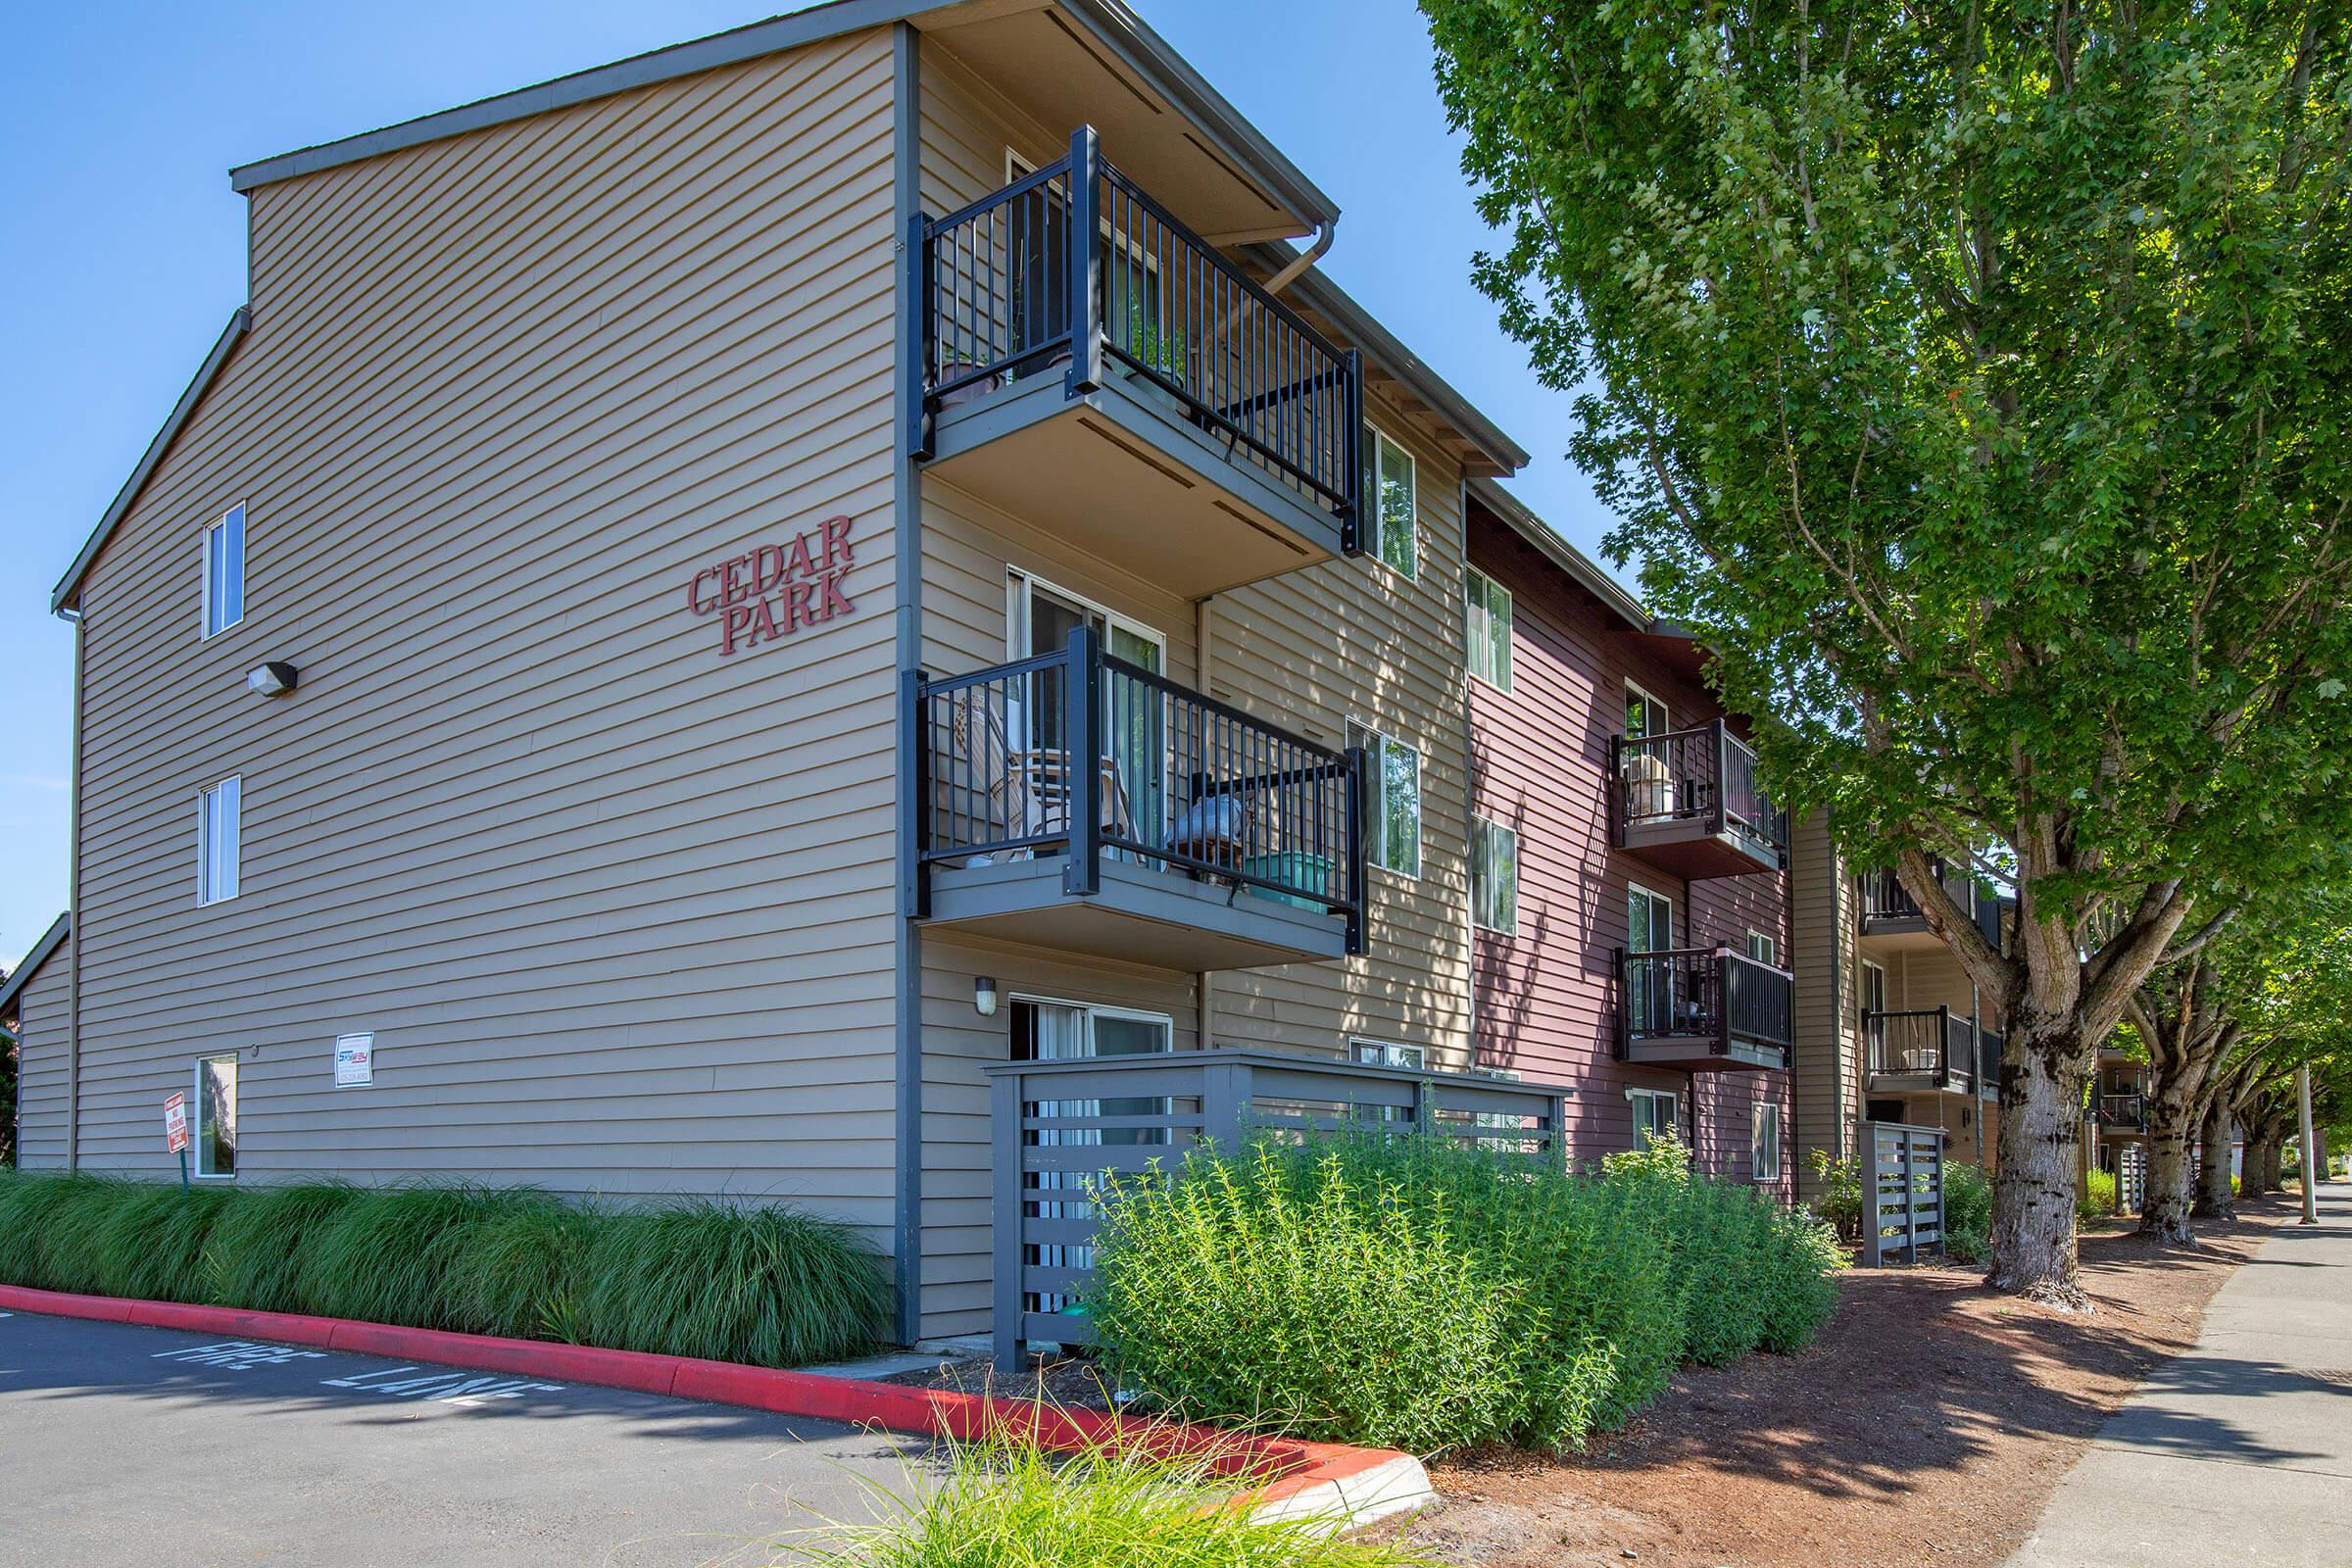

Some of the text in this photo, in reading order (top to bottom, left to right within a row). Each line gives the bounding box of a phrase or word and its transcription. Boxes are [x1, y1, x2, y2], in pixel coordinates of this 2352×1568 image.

[687, 514, 854, 615] CEDAR
[718, 563, 855, 656] PARK
[150, 1342, 566, 1406] FIRE LANE
